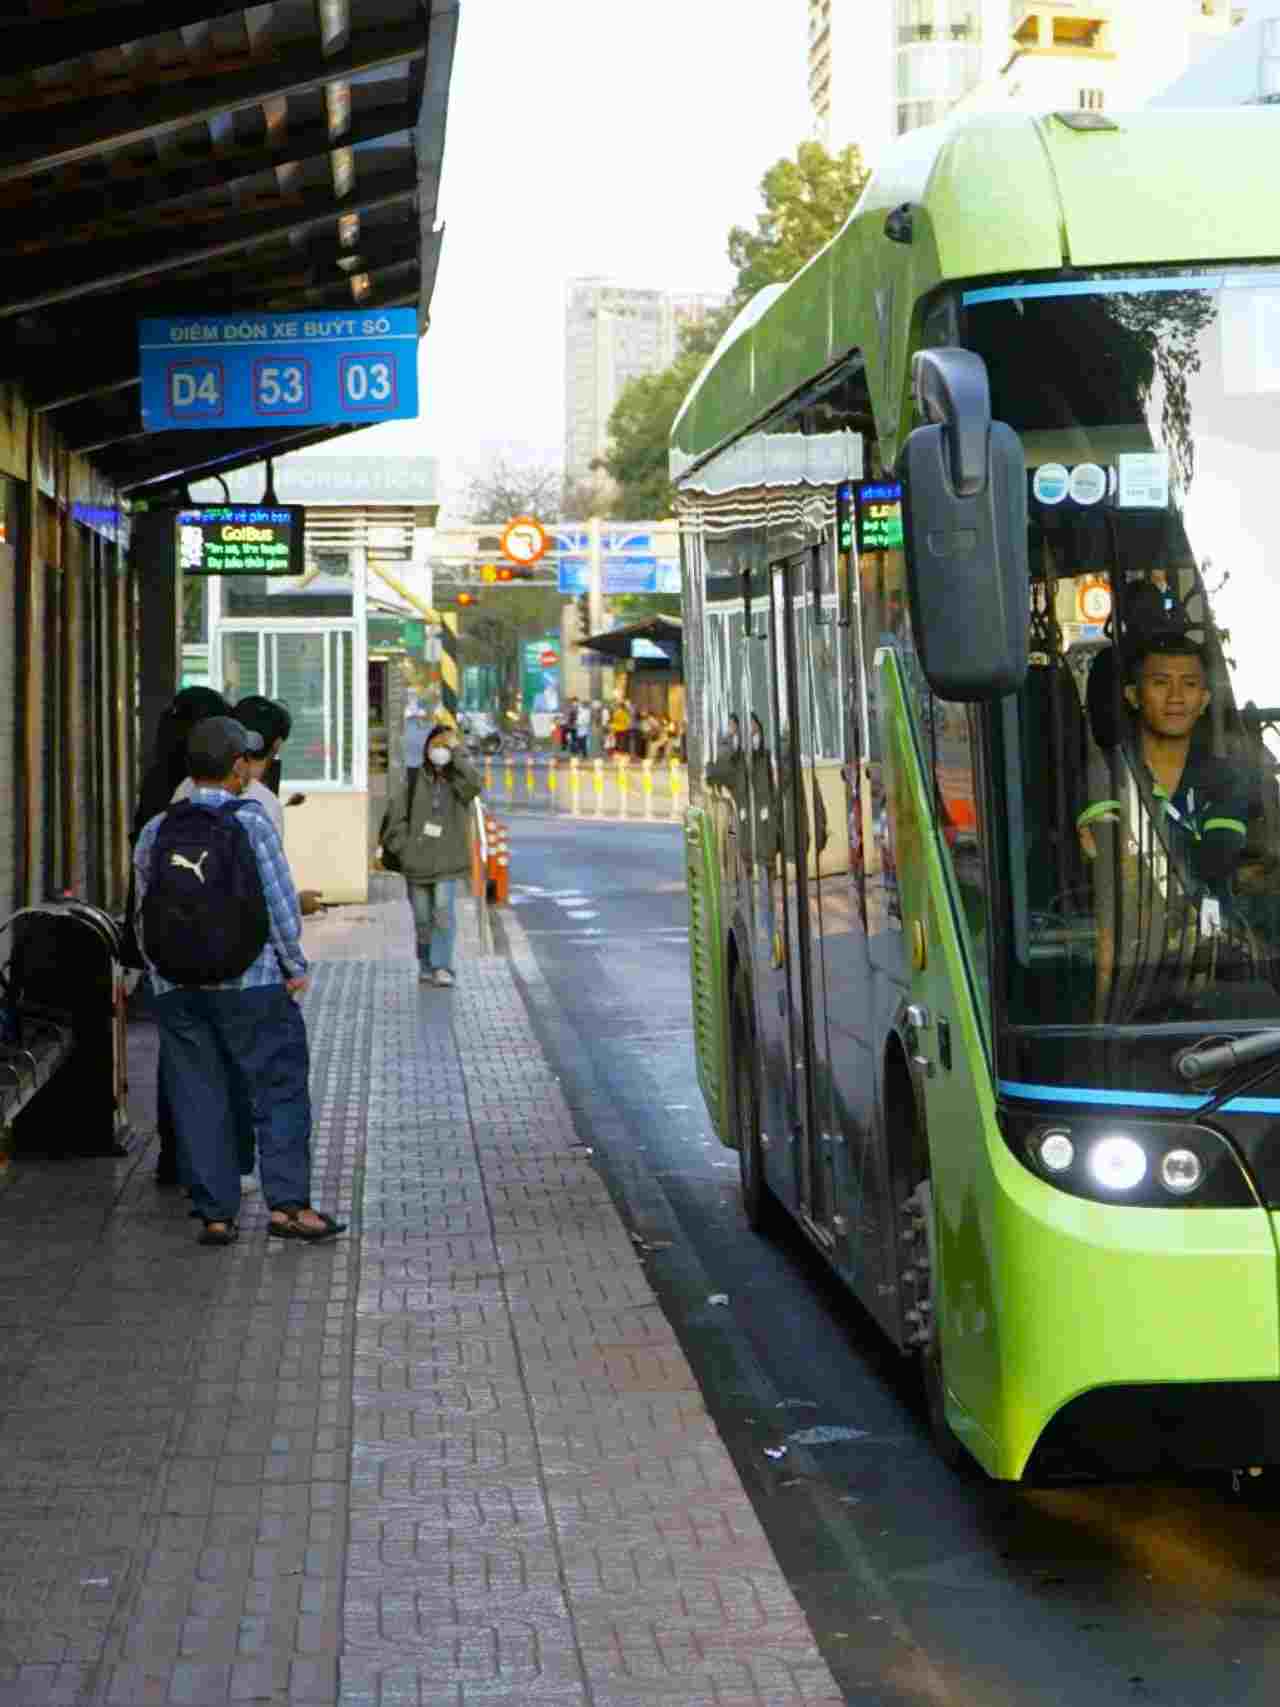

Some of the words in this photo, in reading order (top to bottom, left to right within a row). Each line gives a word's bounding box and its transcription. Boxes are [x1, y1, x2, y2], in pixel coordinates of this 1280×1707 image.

[271, 320, 298, 338] XE
[304, 316, 357, 337] BUÝT
[172, 373, 220, 407] D4
[259, 367, 304, 405] 53
[346, 363, 391, 401] 03
